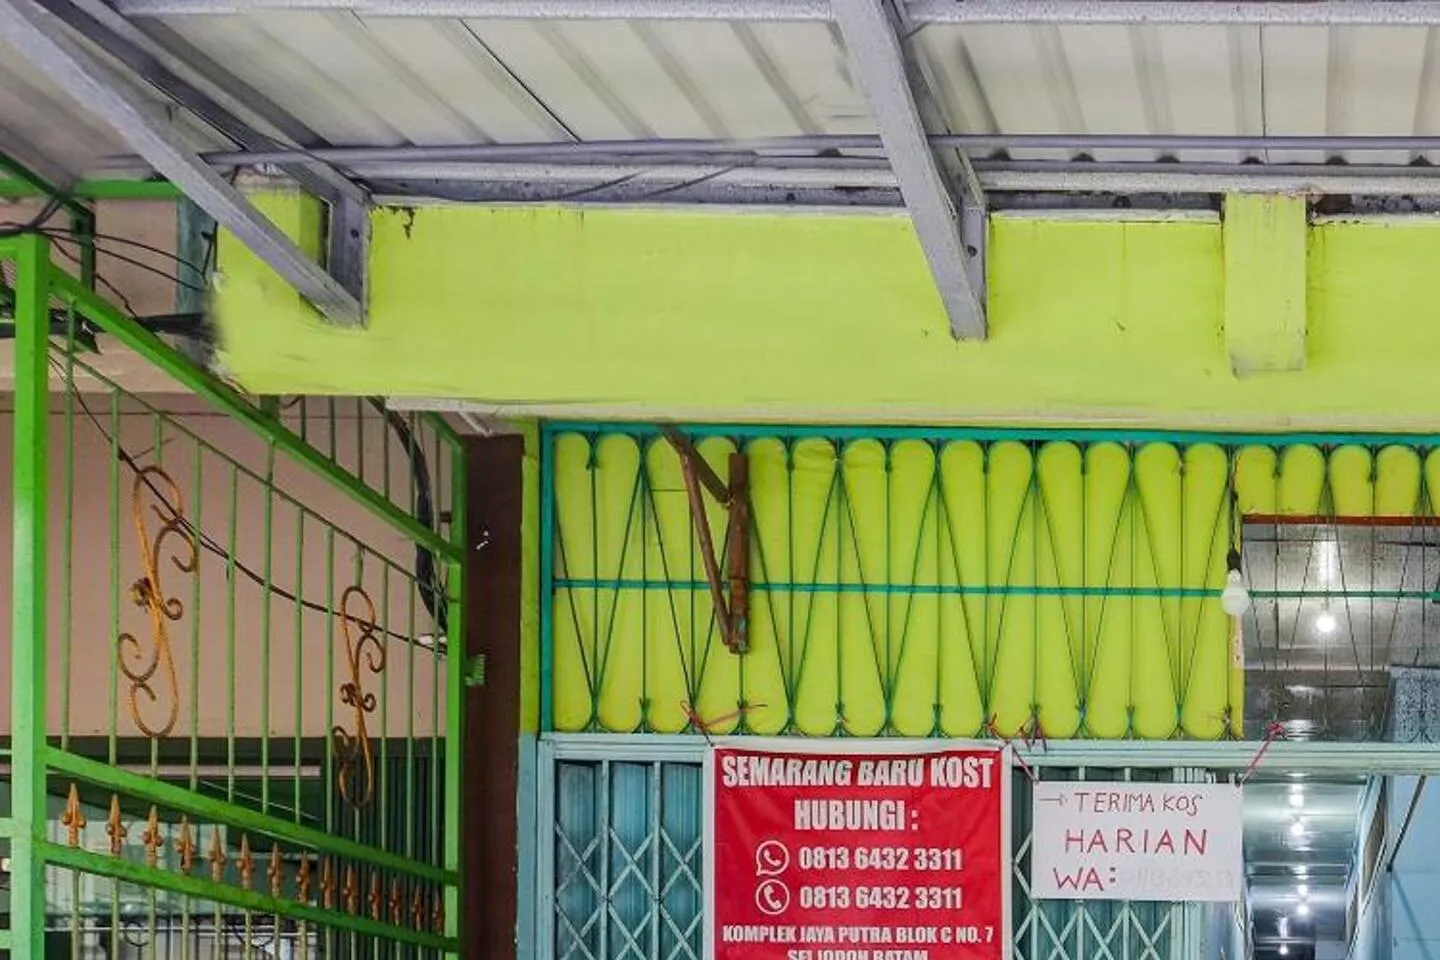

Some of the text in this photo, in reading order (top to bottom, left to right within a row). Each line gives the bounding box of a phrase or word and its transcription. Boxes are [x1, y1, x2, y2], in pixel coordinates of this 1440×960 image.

[722, 756, 994, 788] SEMARANG BARU KOST
[794, 800, 905, 830] HUBUNGI
[1075, 792, 1203, 817] TERIMA KOS
[1065, 828, 1207, 855] HARIAN
[799, 847, 963, 871] 0813 6432 3311
[799, 886, 963, 909] 0813 6432 3311
[723, 925, 797, 942] KOMPLEK
[800, 925, 835, 942] JAYA
[838, 926, 892, 943] PUTRA
[896, 926, 937, 943] BLOK
[956, 926, 982, 943] NO.
[984, 926, 994, 943] 7
